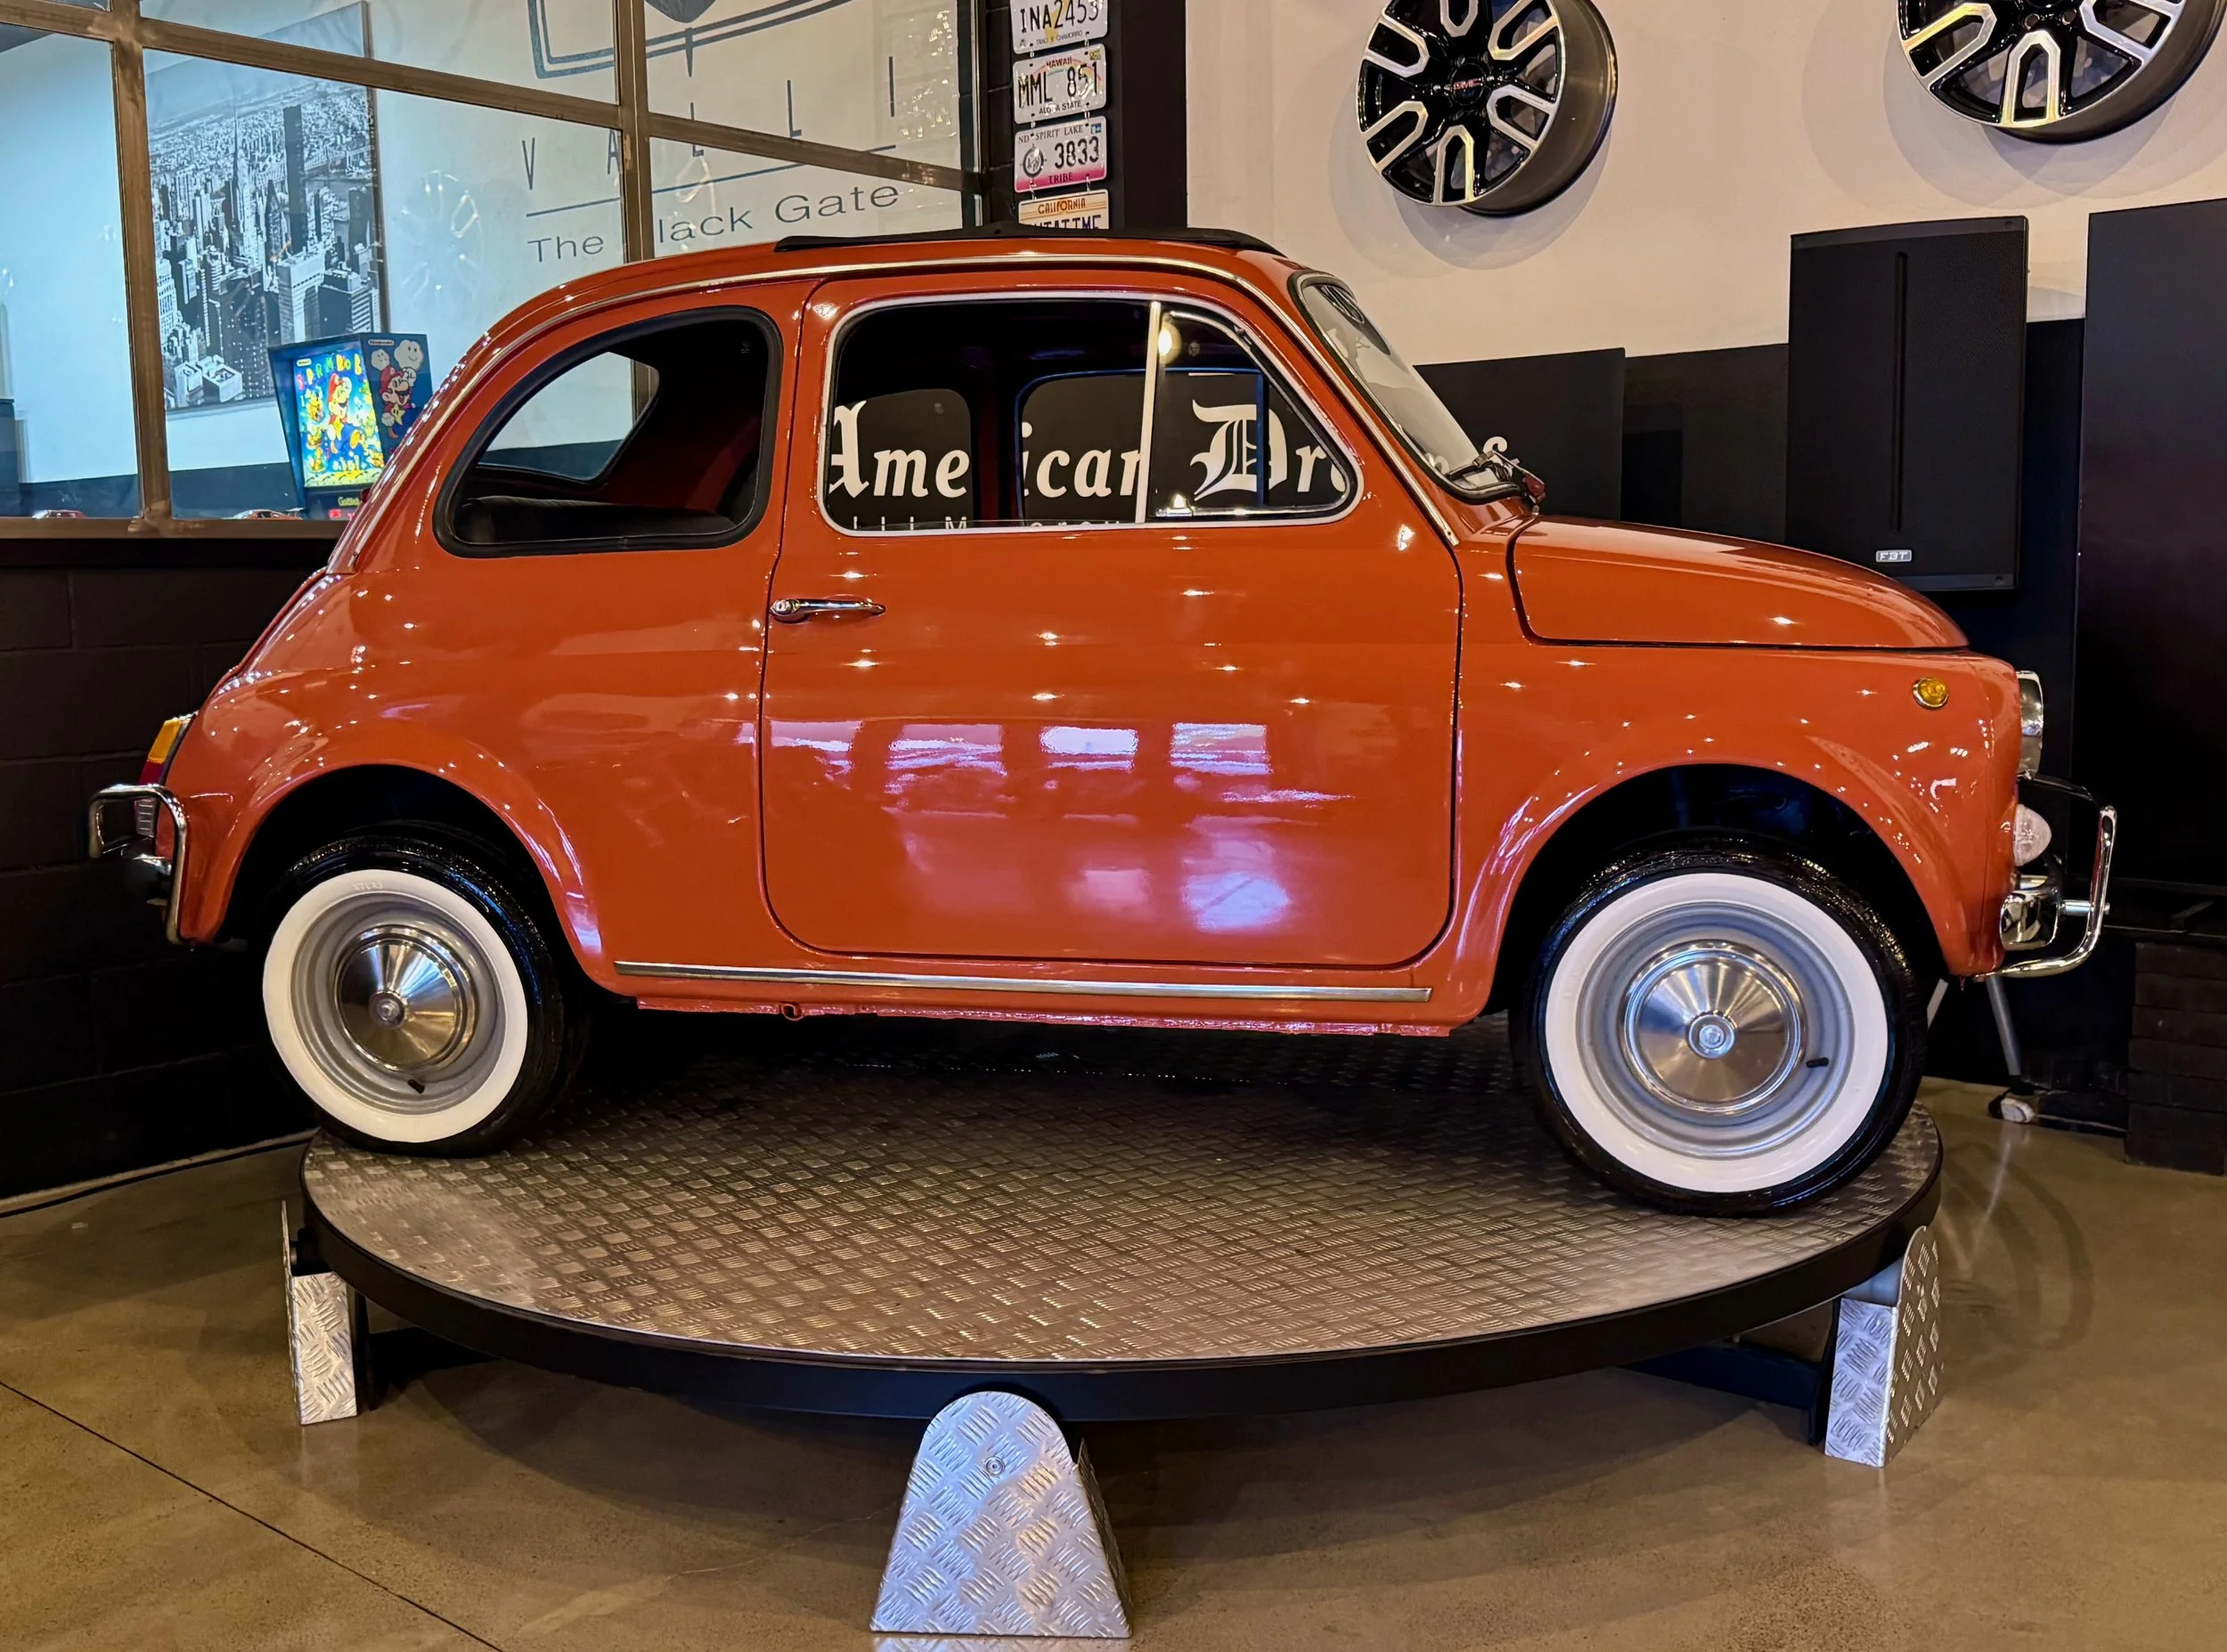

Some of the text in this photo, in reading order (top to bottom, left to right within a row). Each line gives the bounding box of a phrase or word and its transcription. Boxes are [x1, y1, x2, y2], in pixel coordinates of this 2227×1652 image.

[1018, 71, 1053, 109] MML
[1039, 100, 1081, 115] ALOA STATE
[1018, 124, 1083, 143] ND SPIRIT LAKE
[1054, 135, 1099, 169] 3833
[1048, 172, 1074, 185] TRIBE
[1038, 197, 1086, 215] CALIFORNIA
[527, 185, 899, 263] The lack Gate
